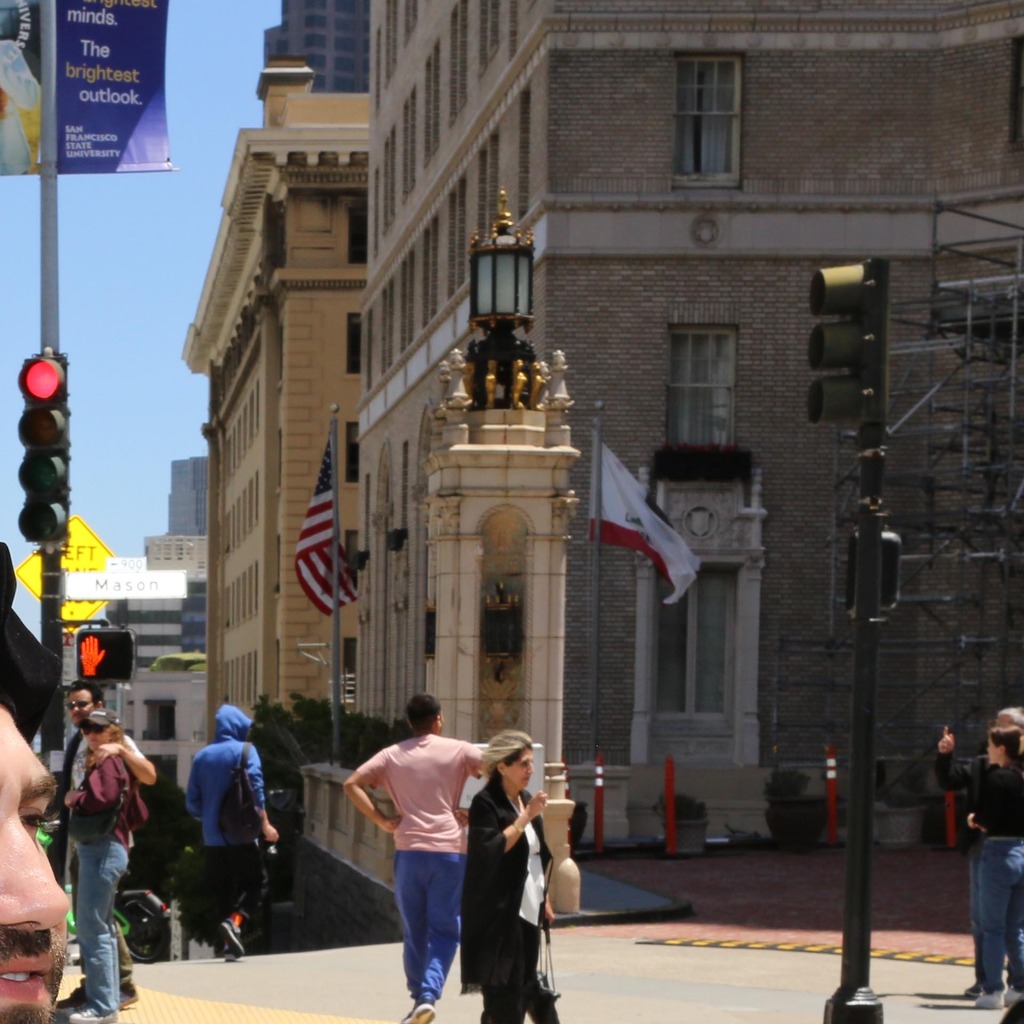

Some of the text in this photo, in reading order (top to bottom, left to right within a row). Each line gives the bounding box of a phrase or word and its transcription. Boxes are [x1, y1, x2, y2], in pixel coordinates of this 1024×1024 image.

[67, 6, 118, 26] minds.
[80, 39, 110, 58] The
[66, 61, 141, 84] brightest
[79, 87, 143, 105] outlook.
[65, 125, 83, 133] SAN
[65, 133, 118, 142] FRANCISCO
[65, 141, 92, 150] STATE
[66, 150, 121, 158] UNIVERSITY
[64, 545, 97, 561] EFT
[121, 559, 143, 570] 900
[95, 579, 159, 592] Mason
